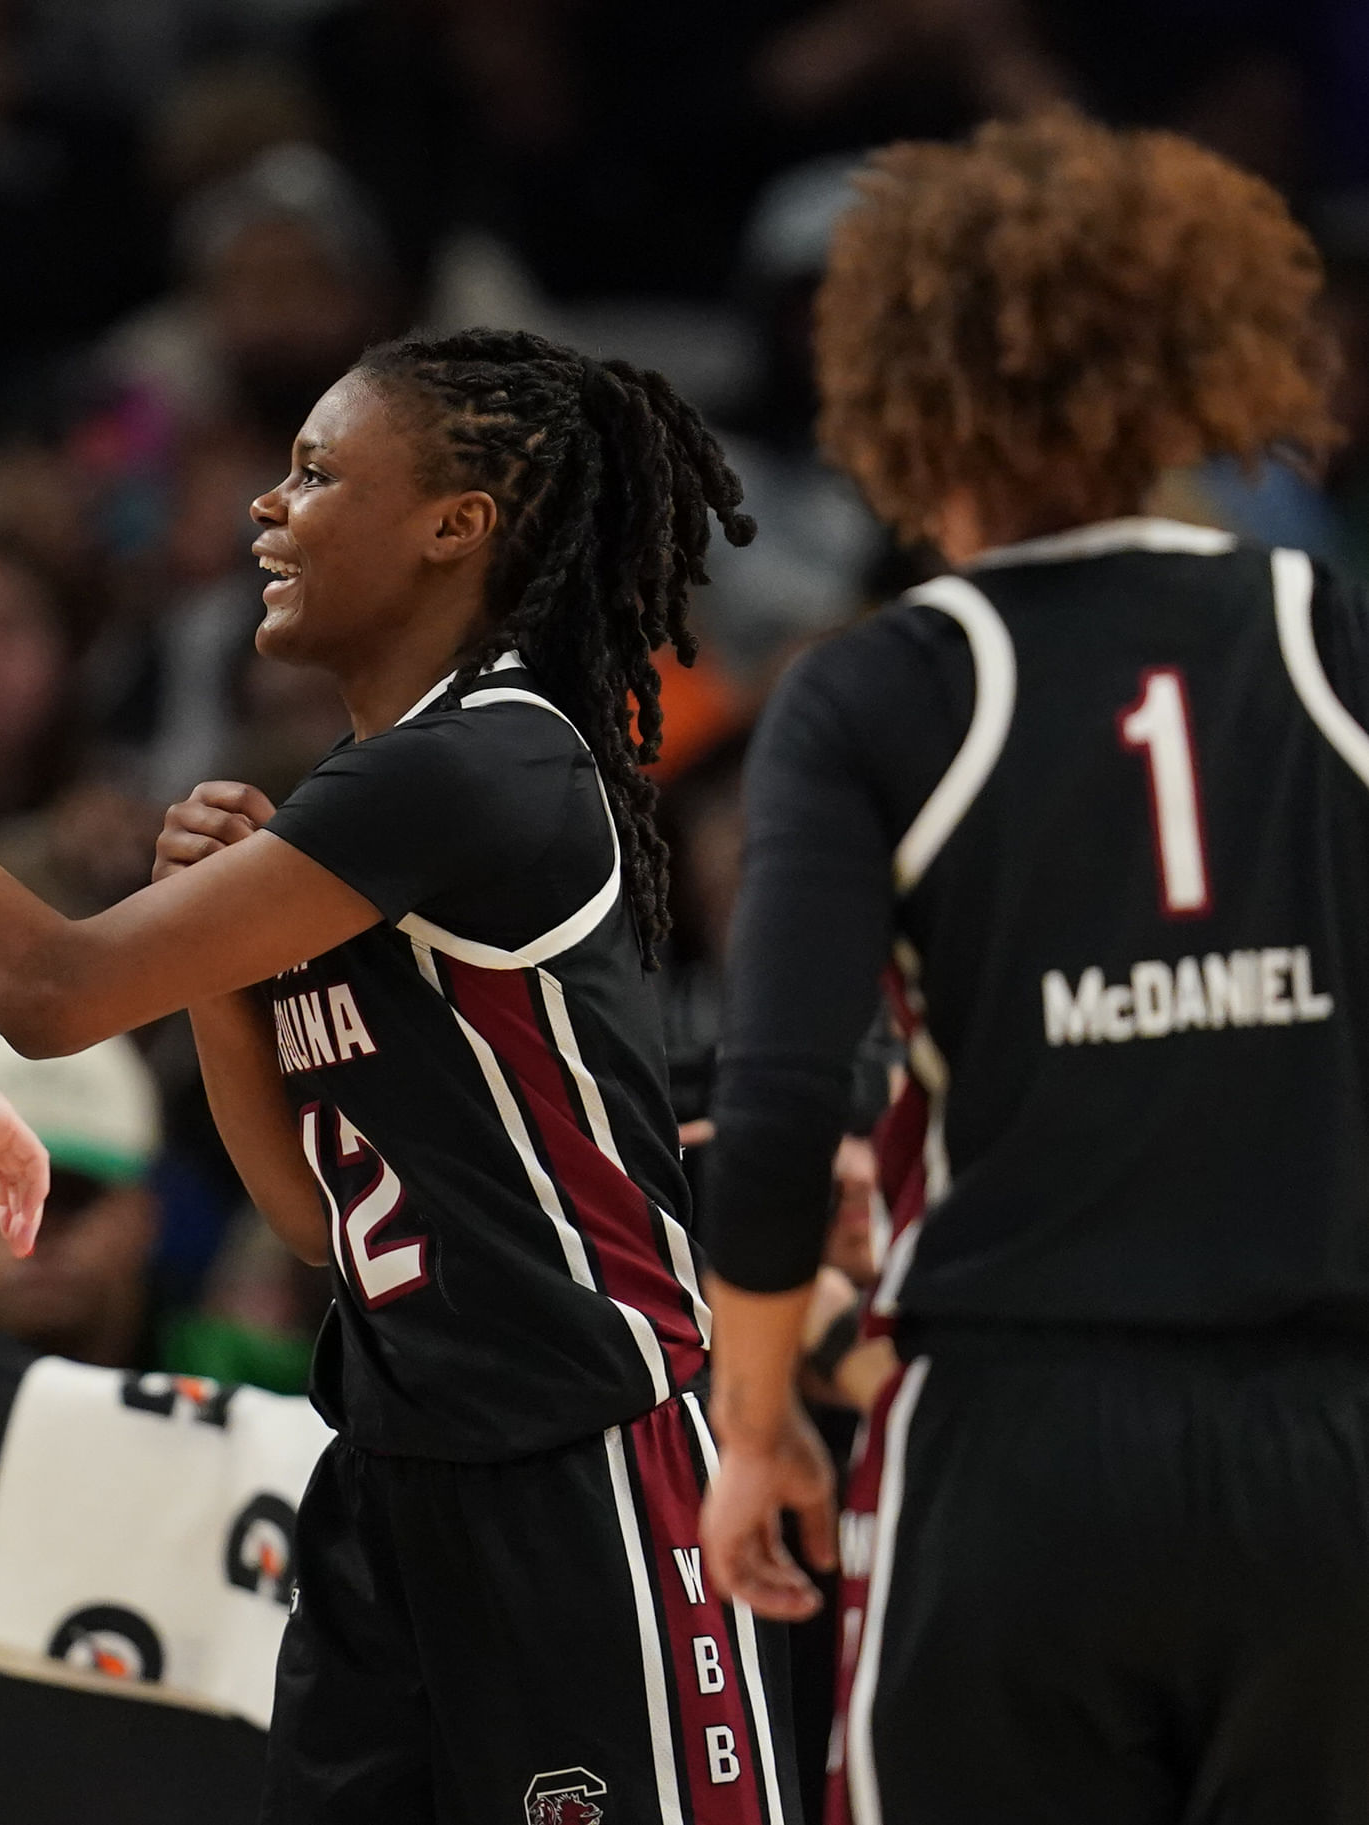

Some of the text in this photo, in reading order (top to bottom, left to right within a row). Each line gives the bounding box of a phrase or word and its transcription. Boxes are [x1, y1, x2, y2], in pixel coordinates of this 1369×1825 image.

[1117, 664, 1213, 918] 1
[1042, 946, 1333, 1047] McDANIEL
[300, 1101, 428, 1311] 12
[672, 1546, 741, 1784] WBB
